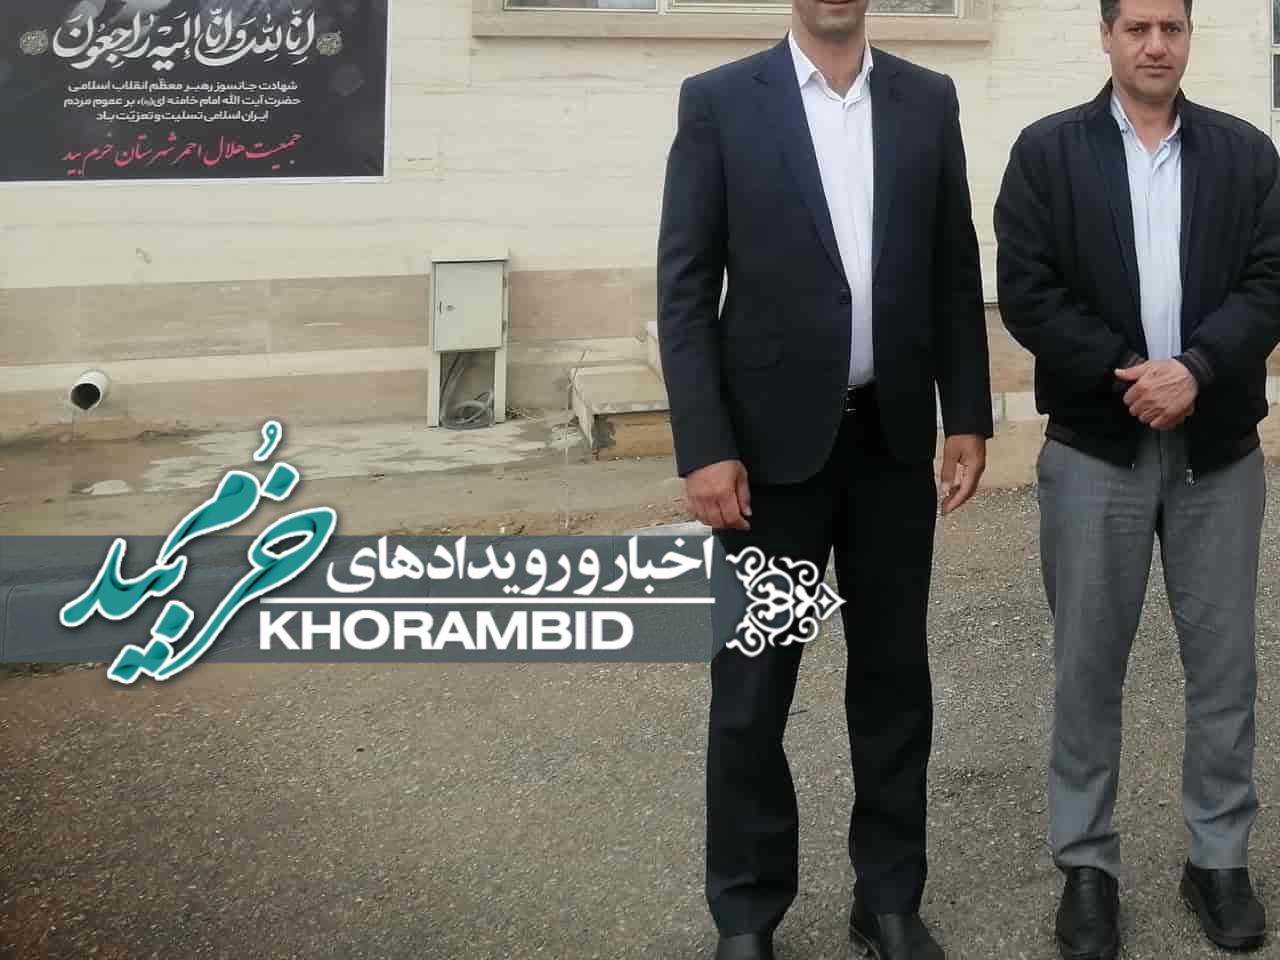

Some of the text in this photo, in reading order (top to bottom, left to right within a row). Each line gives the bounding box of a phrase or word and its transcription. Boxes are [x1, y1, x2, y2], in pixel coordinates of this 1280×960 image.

[68, 80, 110, 93] اسلامی
[112, 80, 148, 93] انقلاب
[258, 80, 298, 93] شهادت
[264, 95, 301, 108] حضرت
[203, 135, 245, 166] هلال
[245, 133, 302, 171] جمعیت
